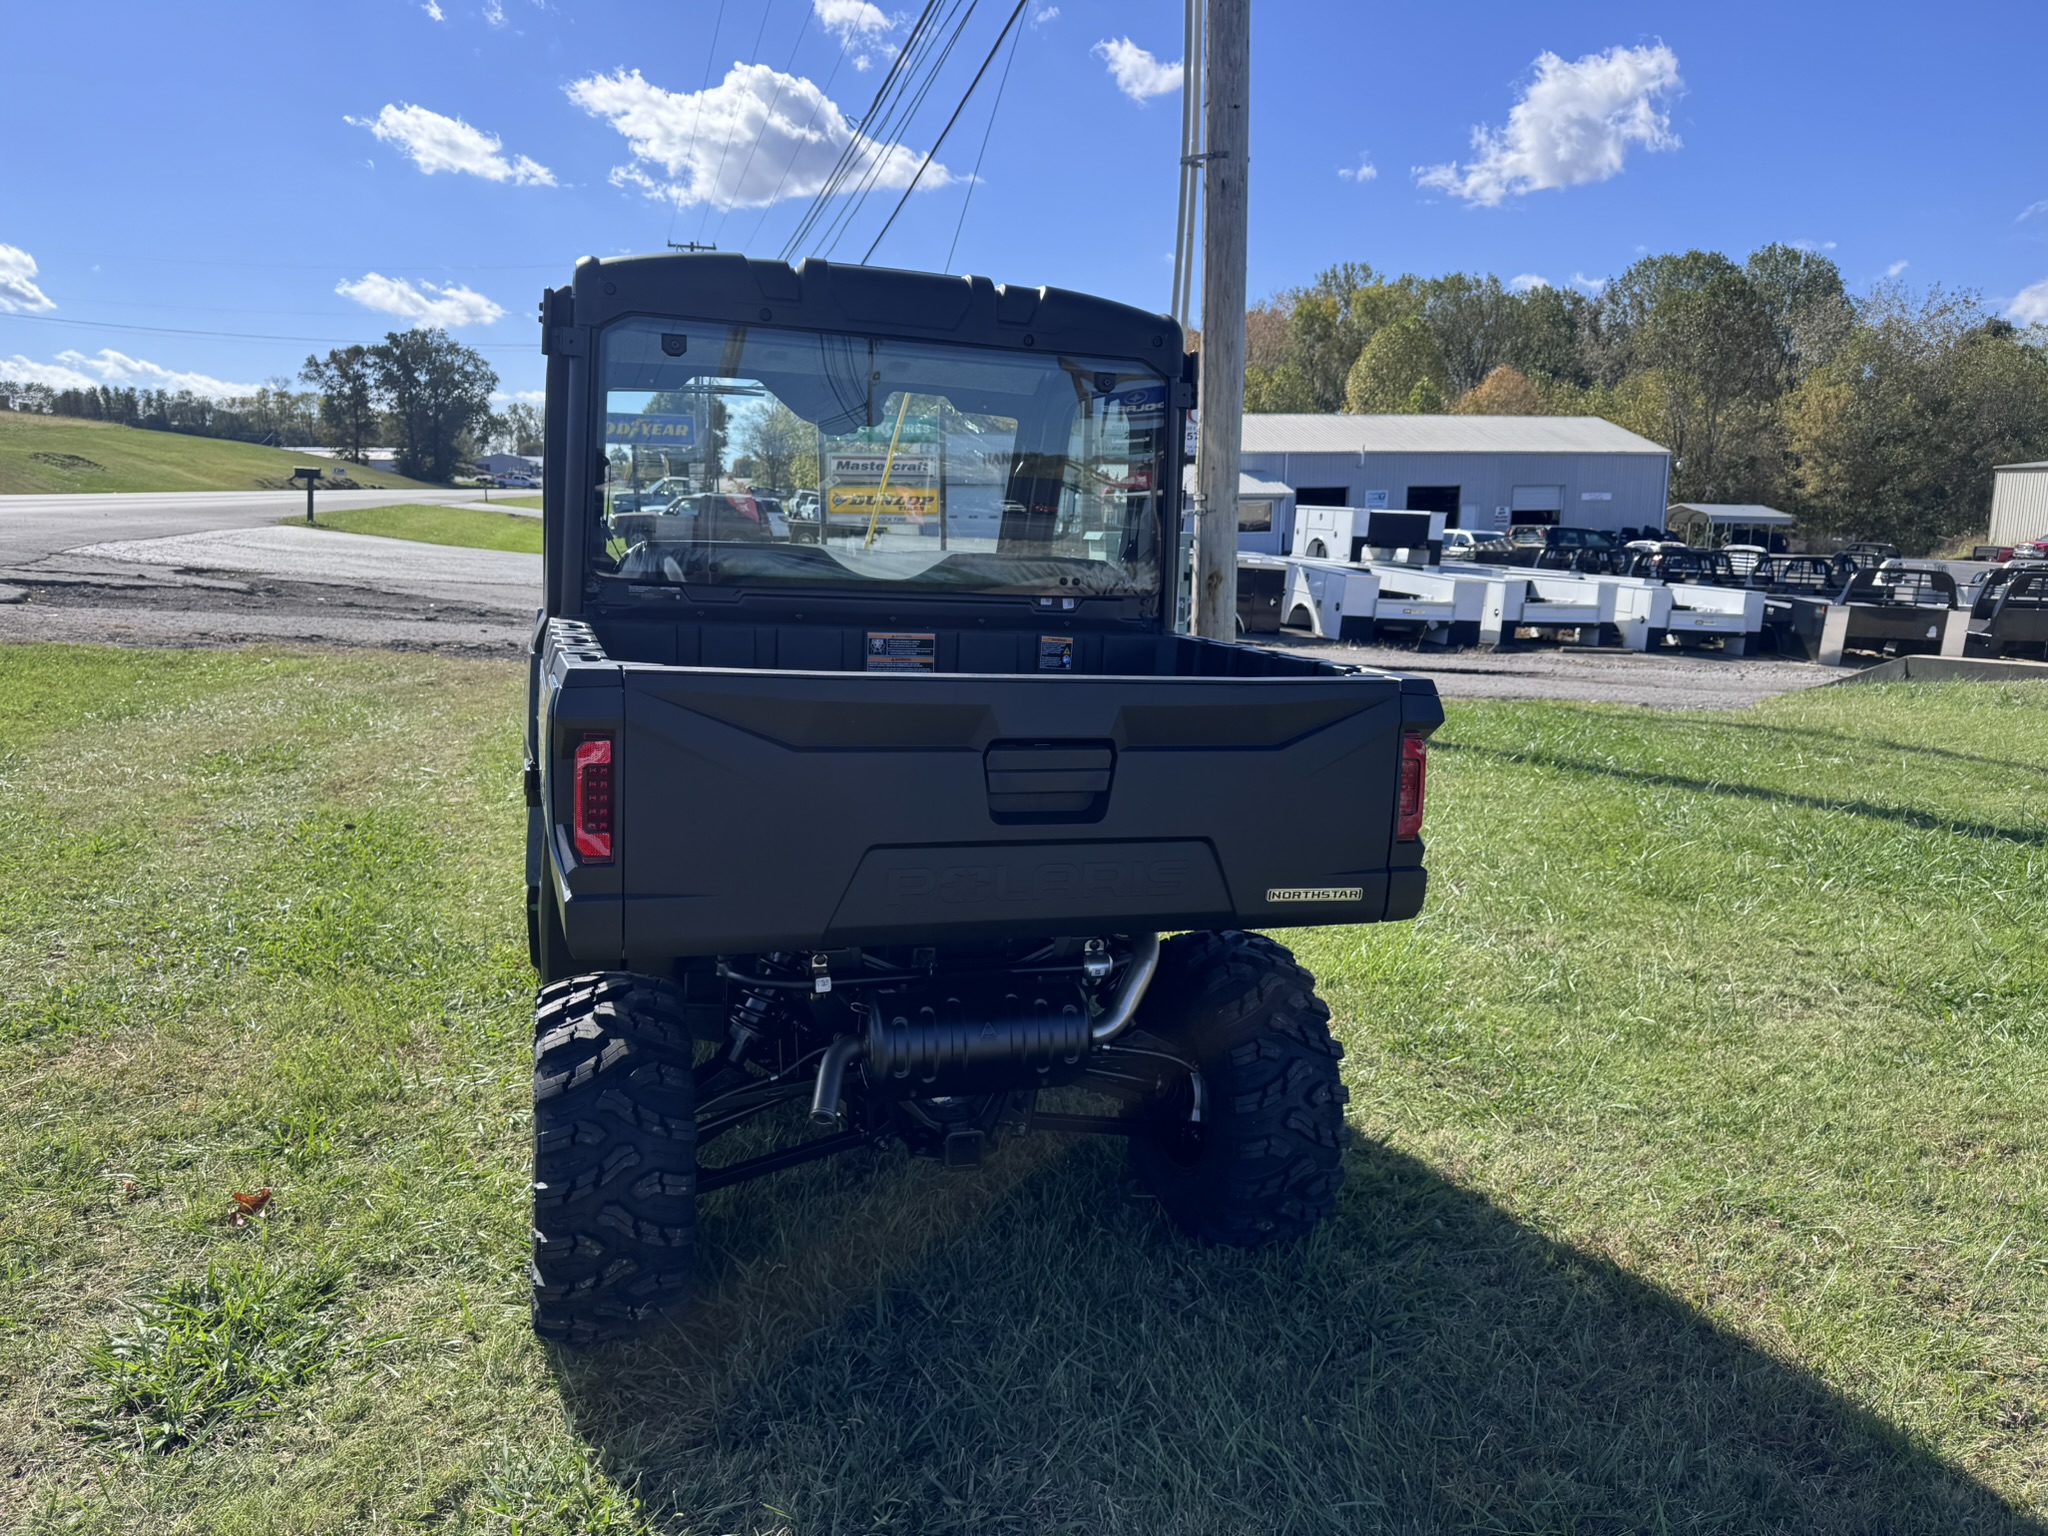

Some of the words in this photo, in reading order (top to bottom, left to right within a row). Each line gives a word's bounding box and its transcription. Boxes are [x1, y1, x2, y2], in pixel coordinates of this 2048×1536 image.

[836, 461, 928, 471] Mastecraft
[887, 861, 1190, 905] POLARIS
[1271, 889, 1359, 900] NORTHSTAR
